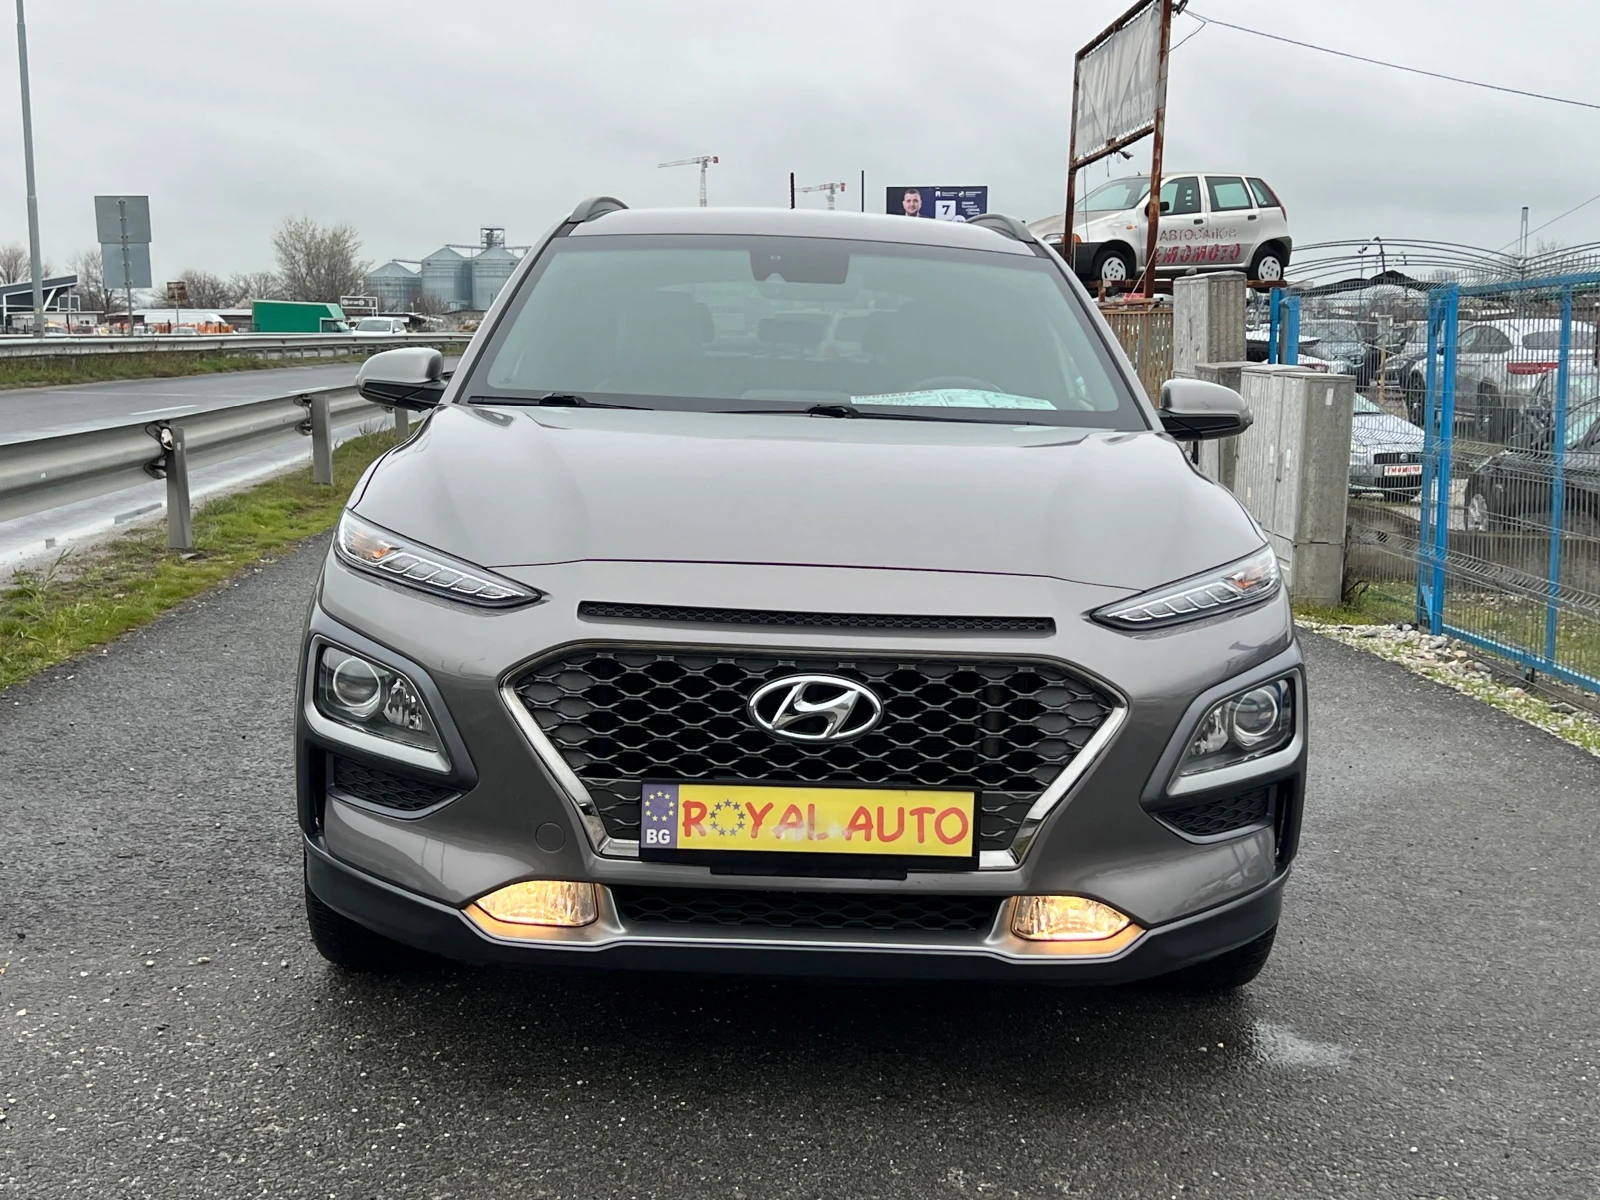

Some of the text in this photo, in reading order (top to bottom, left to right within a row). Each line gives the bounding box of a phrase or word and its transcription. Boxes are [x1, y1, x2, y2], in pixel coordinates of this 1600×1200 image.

[942, 205, 950, 215] 7
[682, 799, 969, 845] ROYAL AUTO
[646, 829, 671, 845] BG
